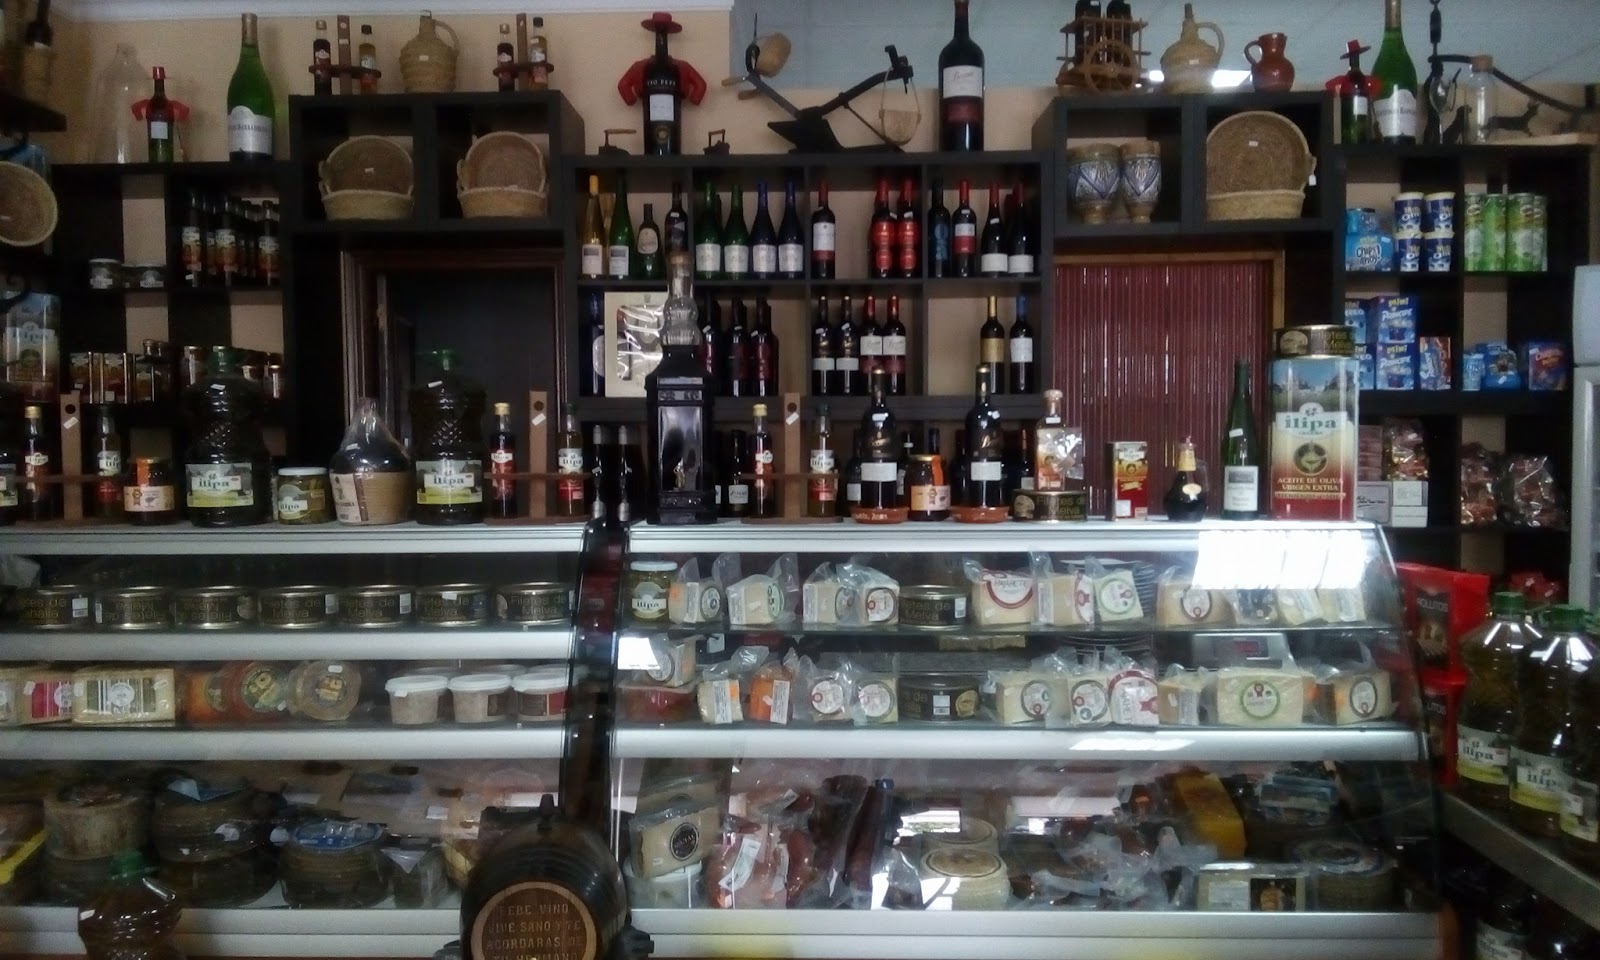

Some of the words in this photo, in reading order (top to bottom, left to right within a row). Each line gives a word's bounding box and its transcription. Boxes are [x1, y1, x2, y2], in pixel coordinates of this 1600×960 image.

[1285, 414, 1337, 433] ilipa
[199, 478, 230, 490] ilipa
[433, 474, 465, 486] ilipa
[522, 605, 558, 615] Melva
[636, 600, 661, 610] ilipa
[1462, 745, 1495, 762] ilipa
[520, 921, 552, 932] SANO
[486, 937, 561, 950] ACORDARAS
